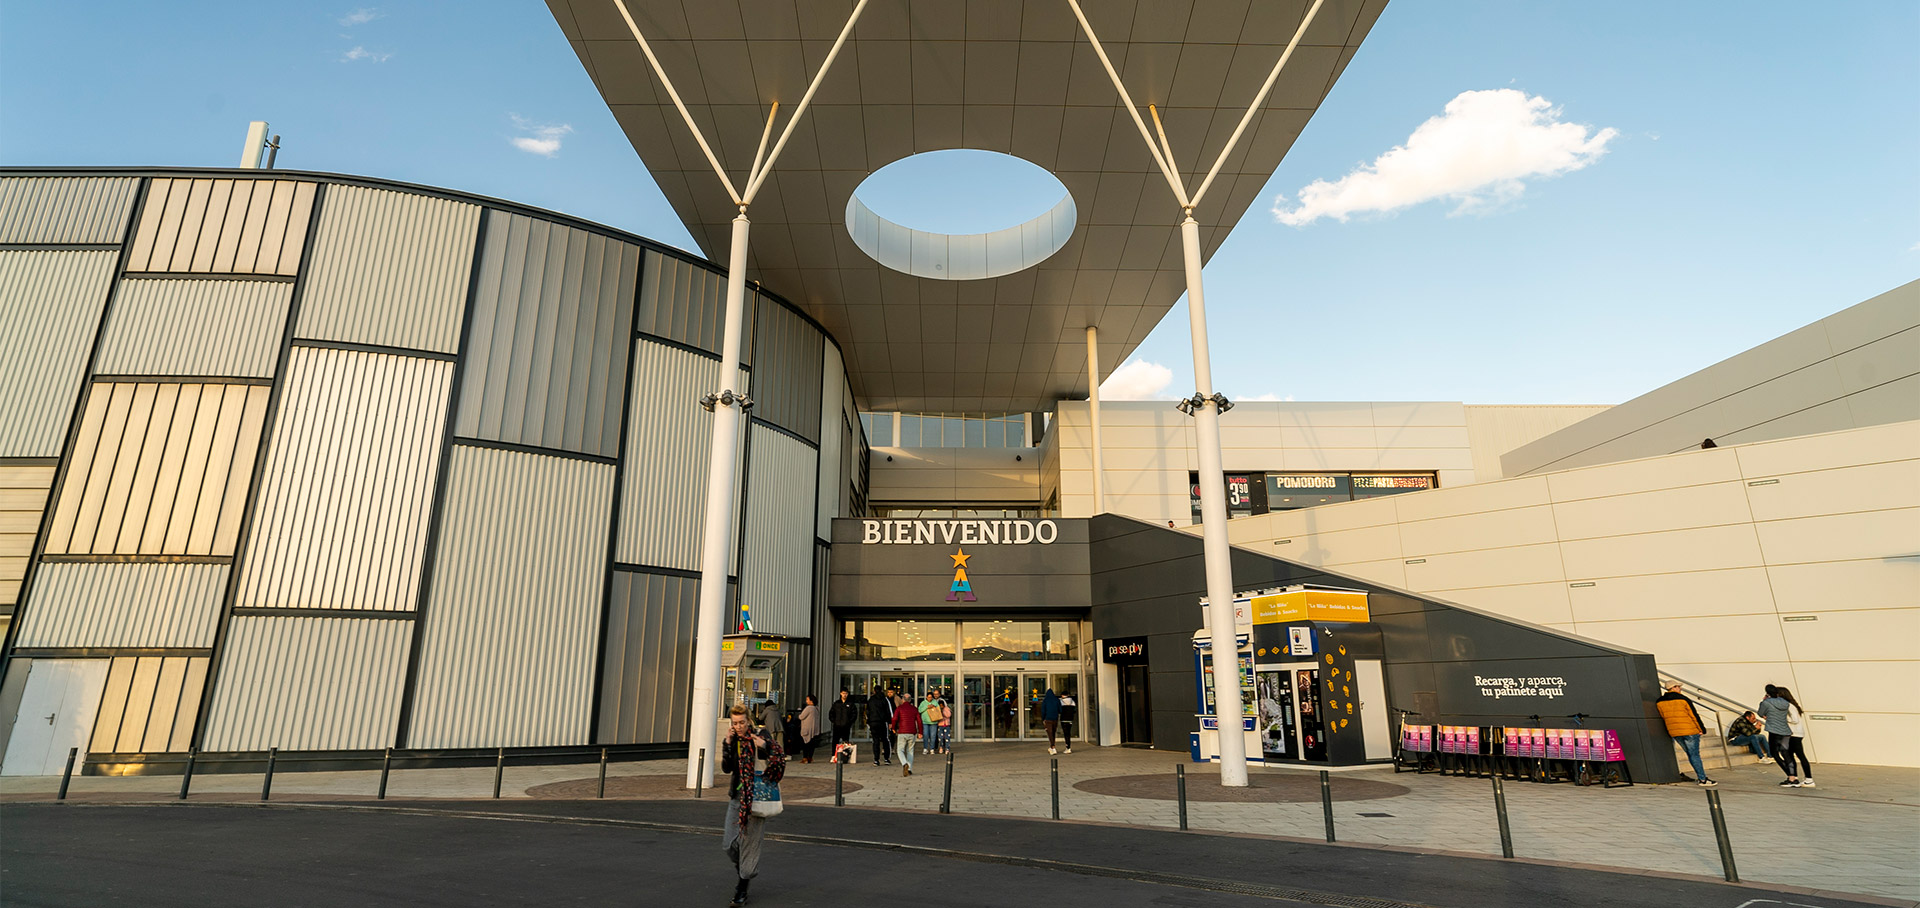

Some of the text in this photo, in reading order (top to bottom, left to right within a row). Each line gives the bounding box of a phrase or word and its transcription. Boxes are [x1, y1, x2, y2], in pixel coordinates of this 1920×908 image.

[1276, 477, 1336, 488] POMODORO
[862, 519, 1058, 545] BIENVENIDO
[1474, 675, 1567, 689] Recarga, y aparca,
[1481, 684, 1564, 699] tu patinete aquí
